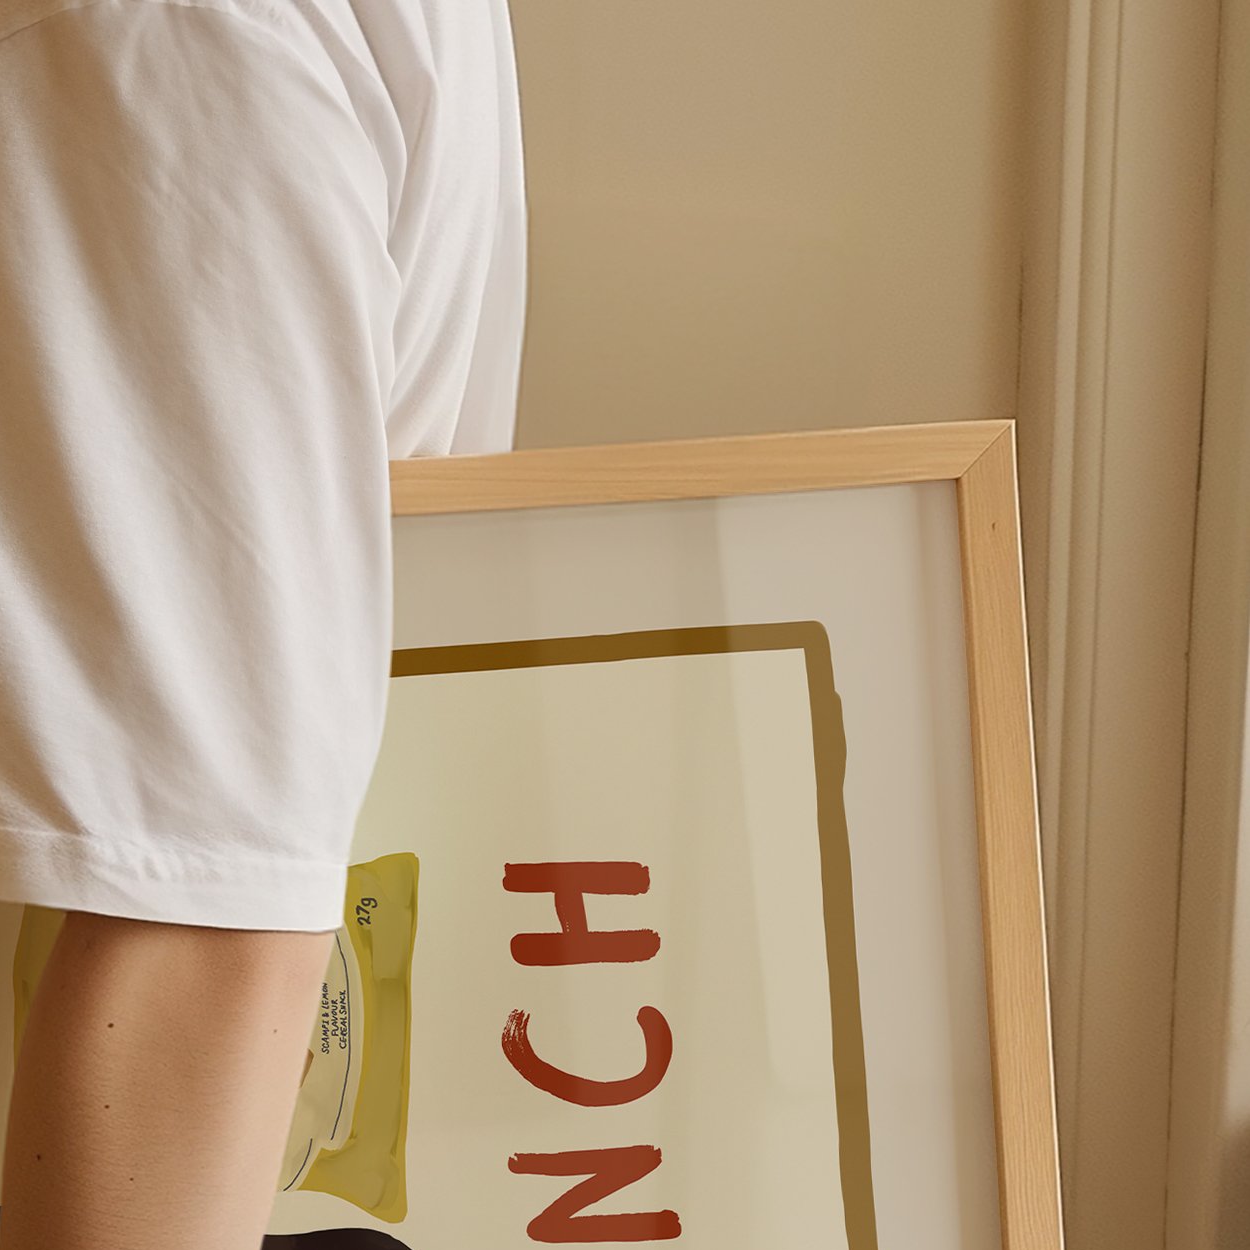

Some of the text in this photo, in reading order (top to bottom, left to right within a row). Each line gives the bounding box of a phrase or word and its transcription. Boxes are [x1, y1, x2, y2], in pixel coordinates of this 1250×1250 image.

[355, 897, 378, 926] 27g
[321, 982, 330, 1010] LEMON
[331, 999, 339, 1037] FLAVOUR
[339, 990, 348, 1050] CEREAL SNACK
[321, 1020, 330, 1054] SCAMPI
